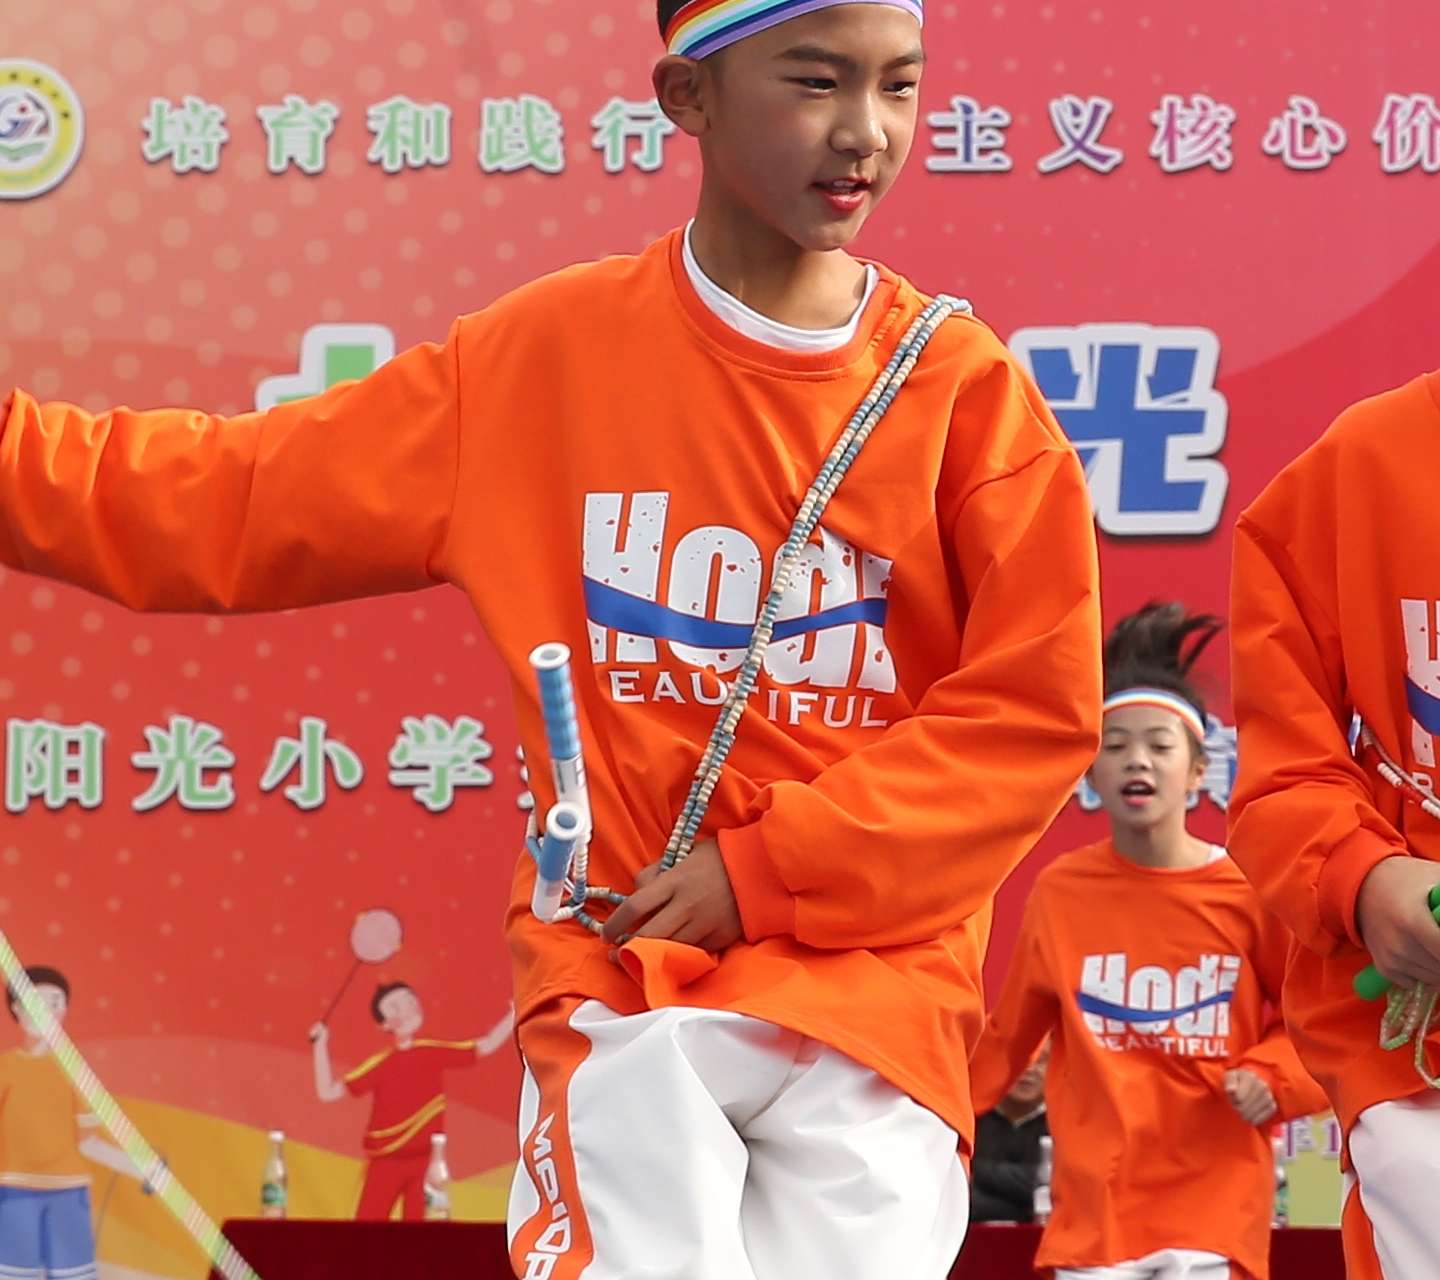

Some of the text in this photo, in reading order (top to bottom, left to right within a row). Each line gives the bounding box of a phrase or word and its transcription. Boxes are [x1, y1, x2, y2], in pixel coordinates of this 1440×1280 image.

[607, 670, 889, 729] EAUIFUL
[4, 713, 534, 813] 阳光小学
